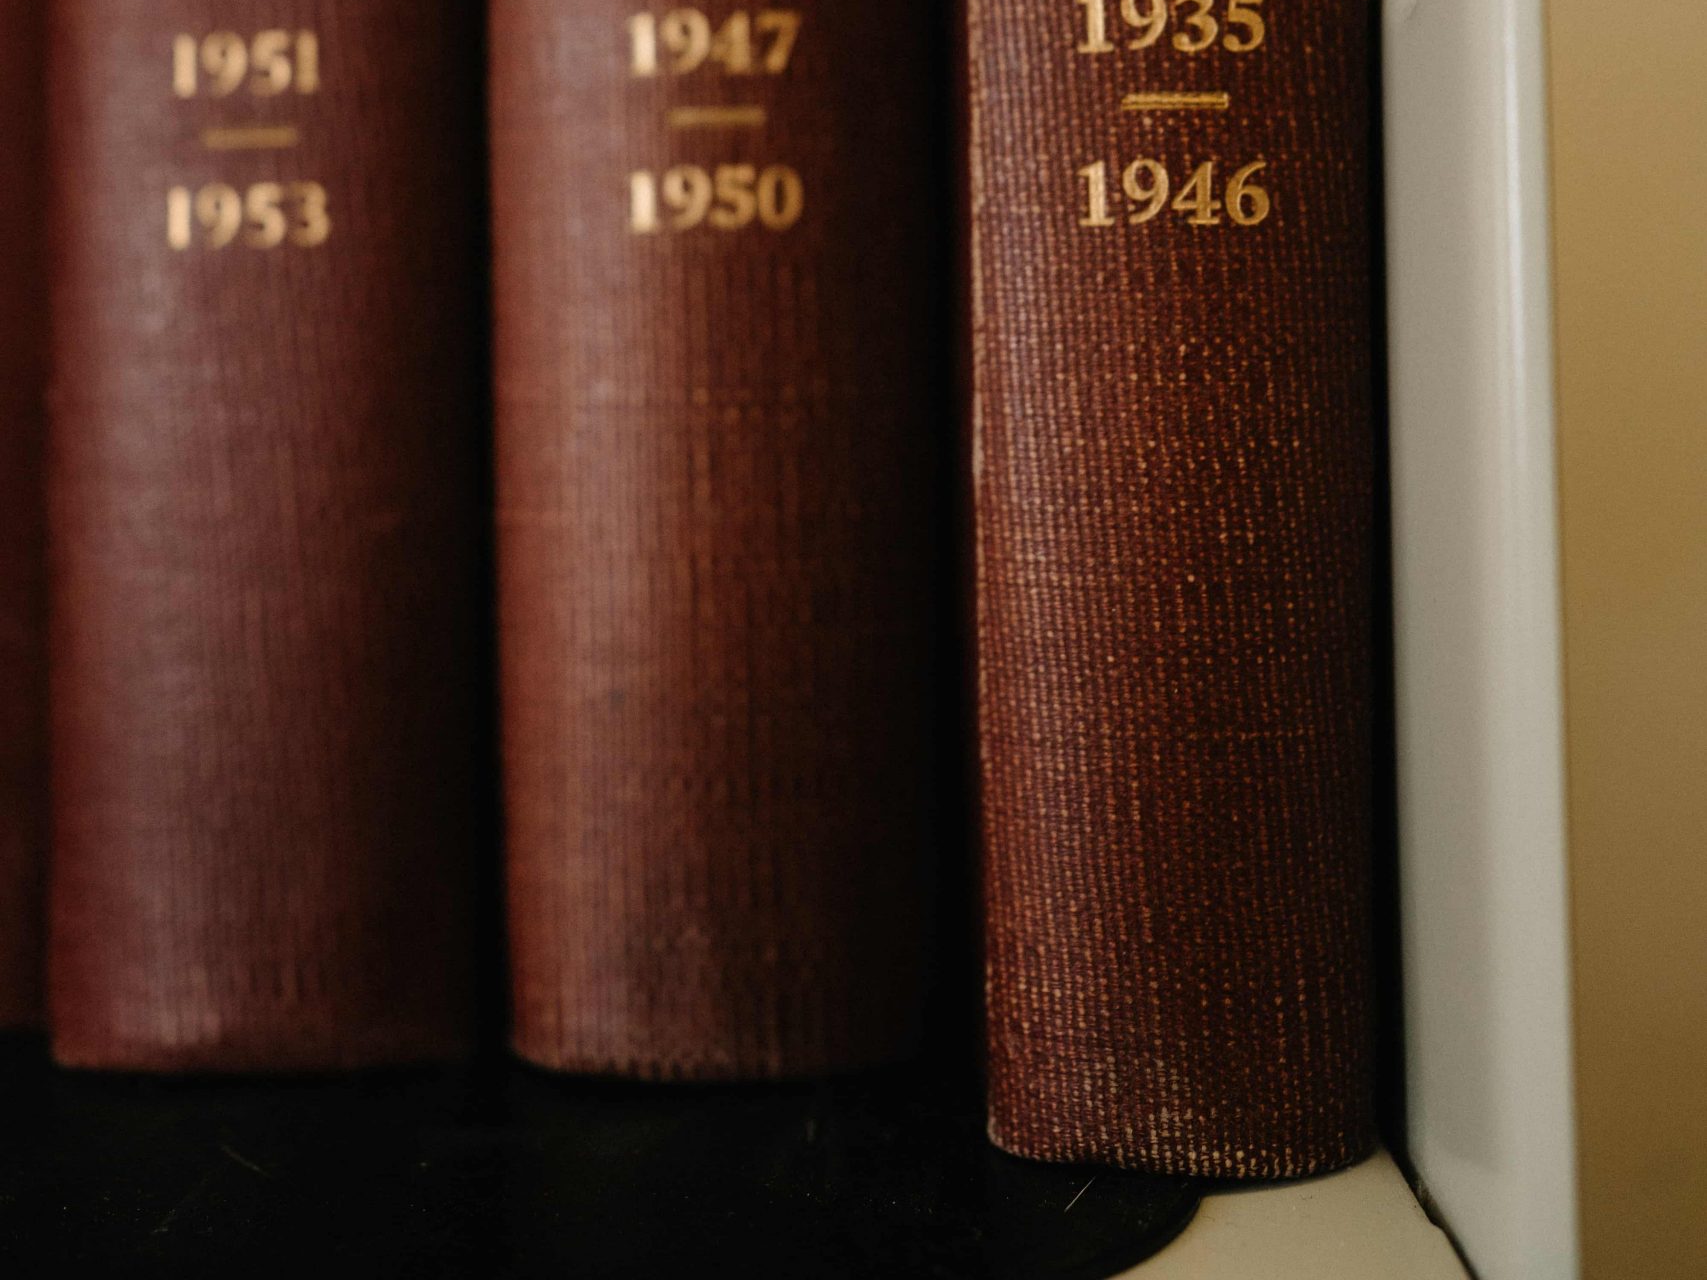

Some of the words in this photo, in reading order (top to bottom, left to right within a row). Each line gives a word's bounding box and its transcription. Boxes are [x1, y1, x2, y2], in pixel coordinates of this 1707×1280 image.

[172, 29, 320, 99] 1951
[628, 7, 799, 78] 1947
[166, 181, 331, 250] 1953
[629, 165, 804, 235] 1950
[1077, 158, 1271, 227] 1946
